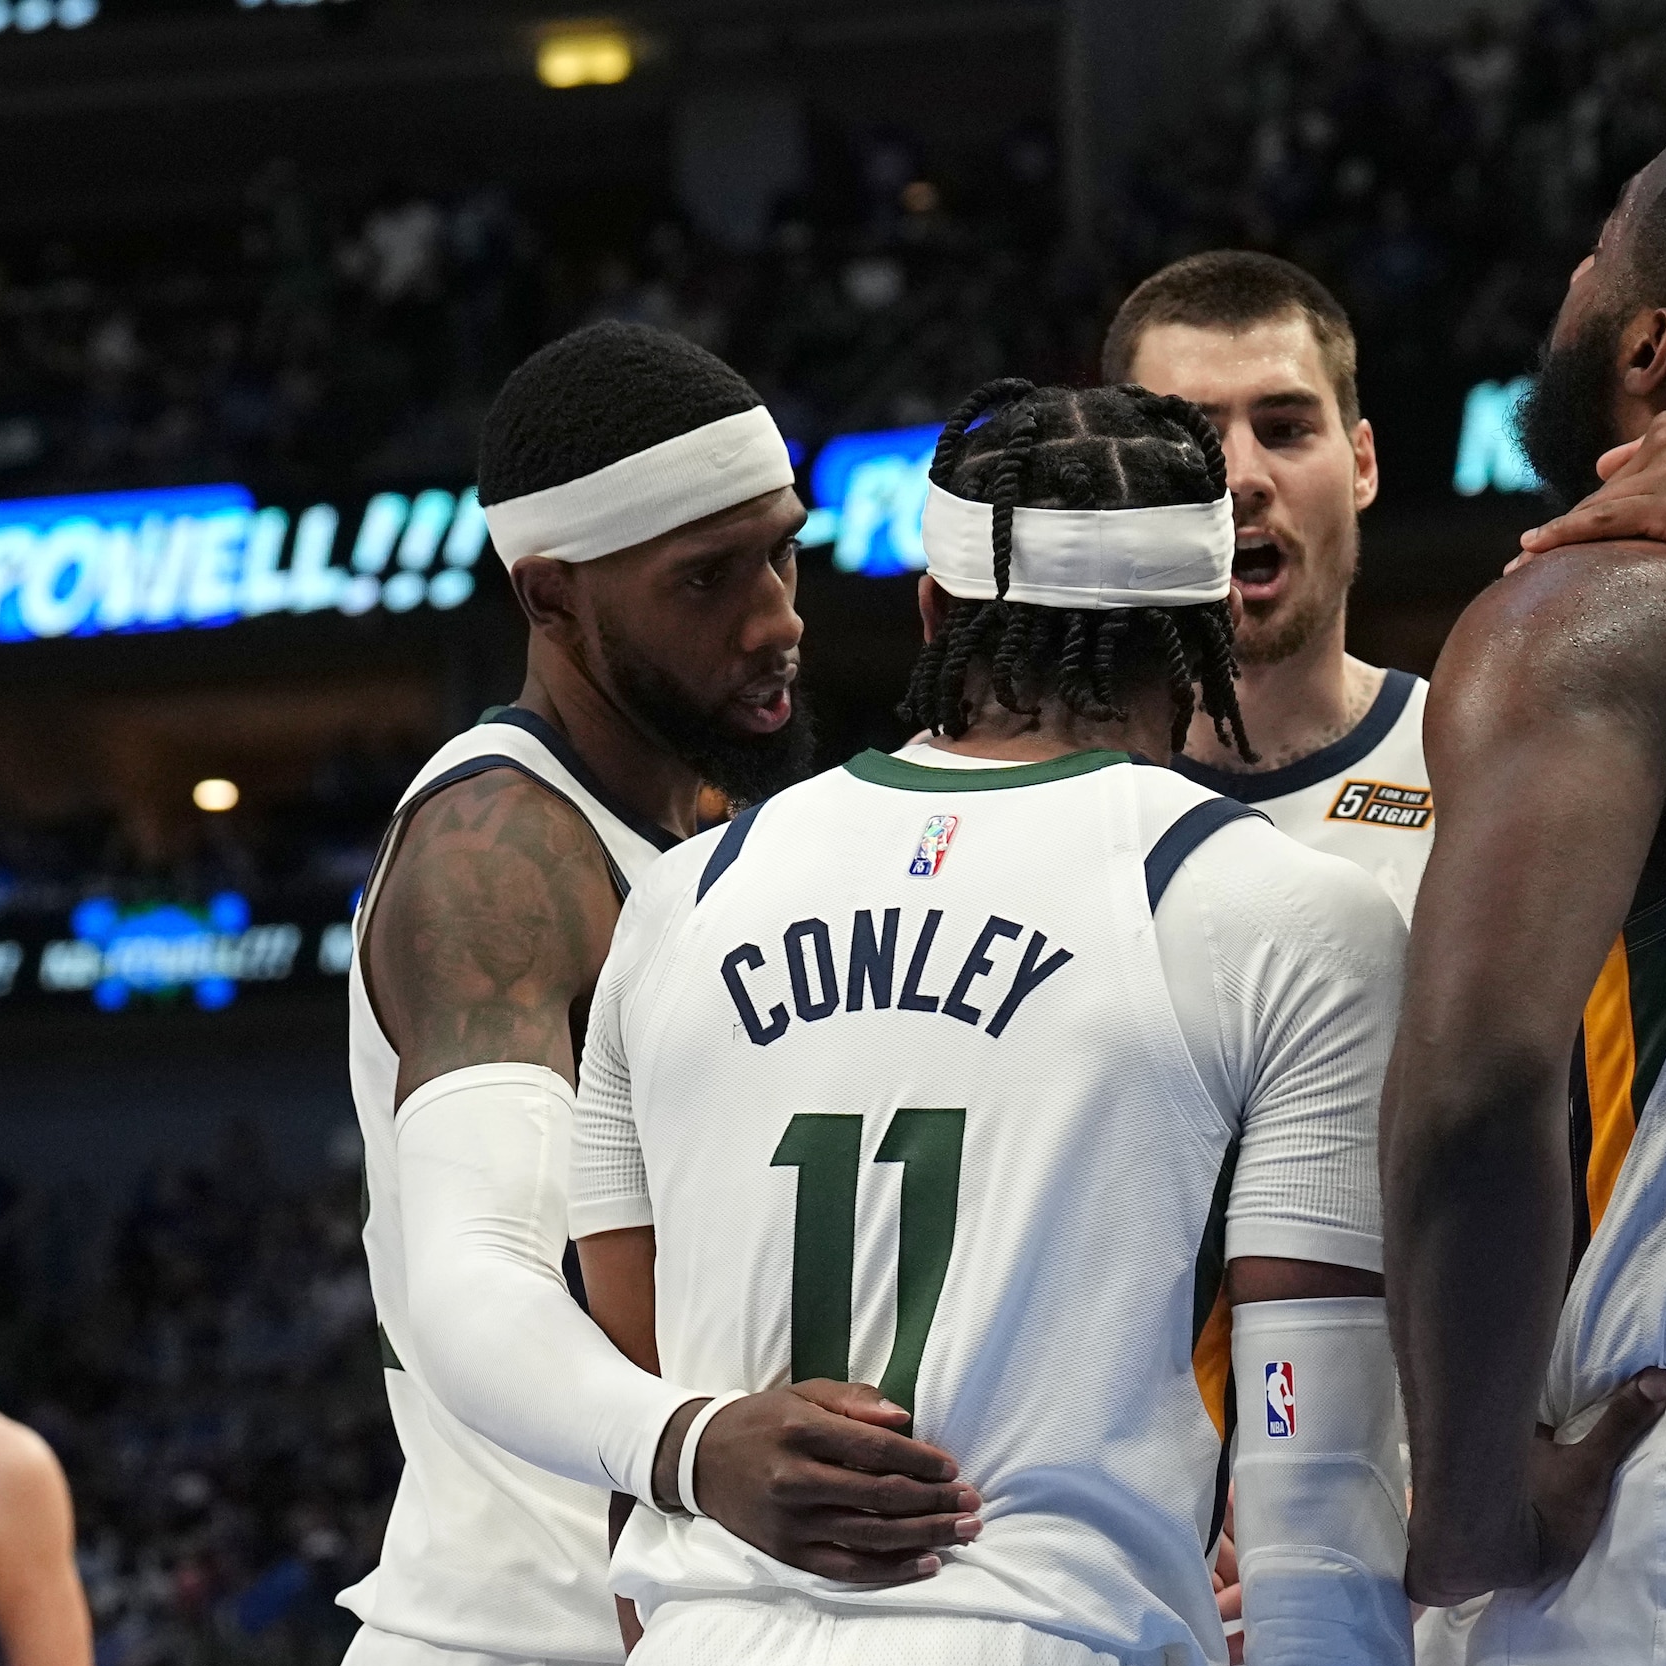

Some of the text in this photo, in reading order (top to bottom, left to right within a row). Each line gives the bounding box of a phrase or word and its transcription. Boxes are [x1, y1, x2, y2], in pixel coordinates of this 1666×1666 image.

[1336, 784, 1370, 818] 5
[1378, 787, 1426, 804] FOR THE
[1365, 803, 1428, 826] FIGHT
[720, 906, 1075, 1047] CONLEY
[770, 1107, 968, 1438] 11
[1269, 1420, 1286, 1435] NBA
